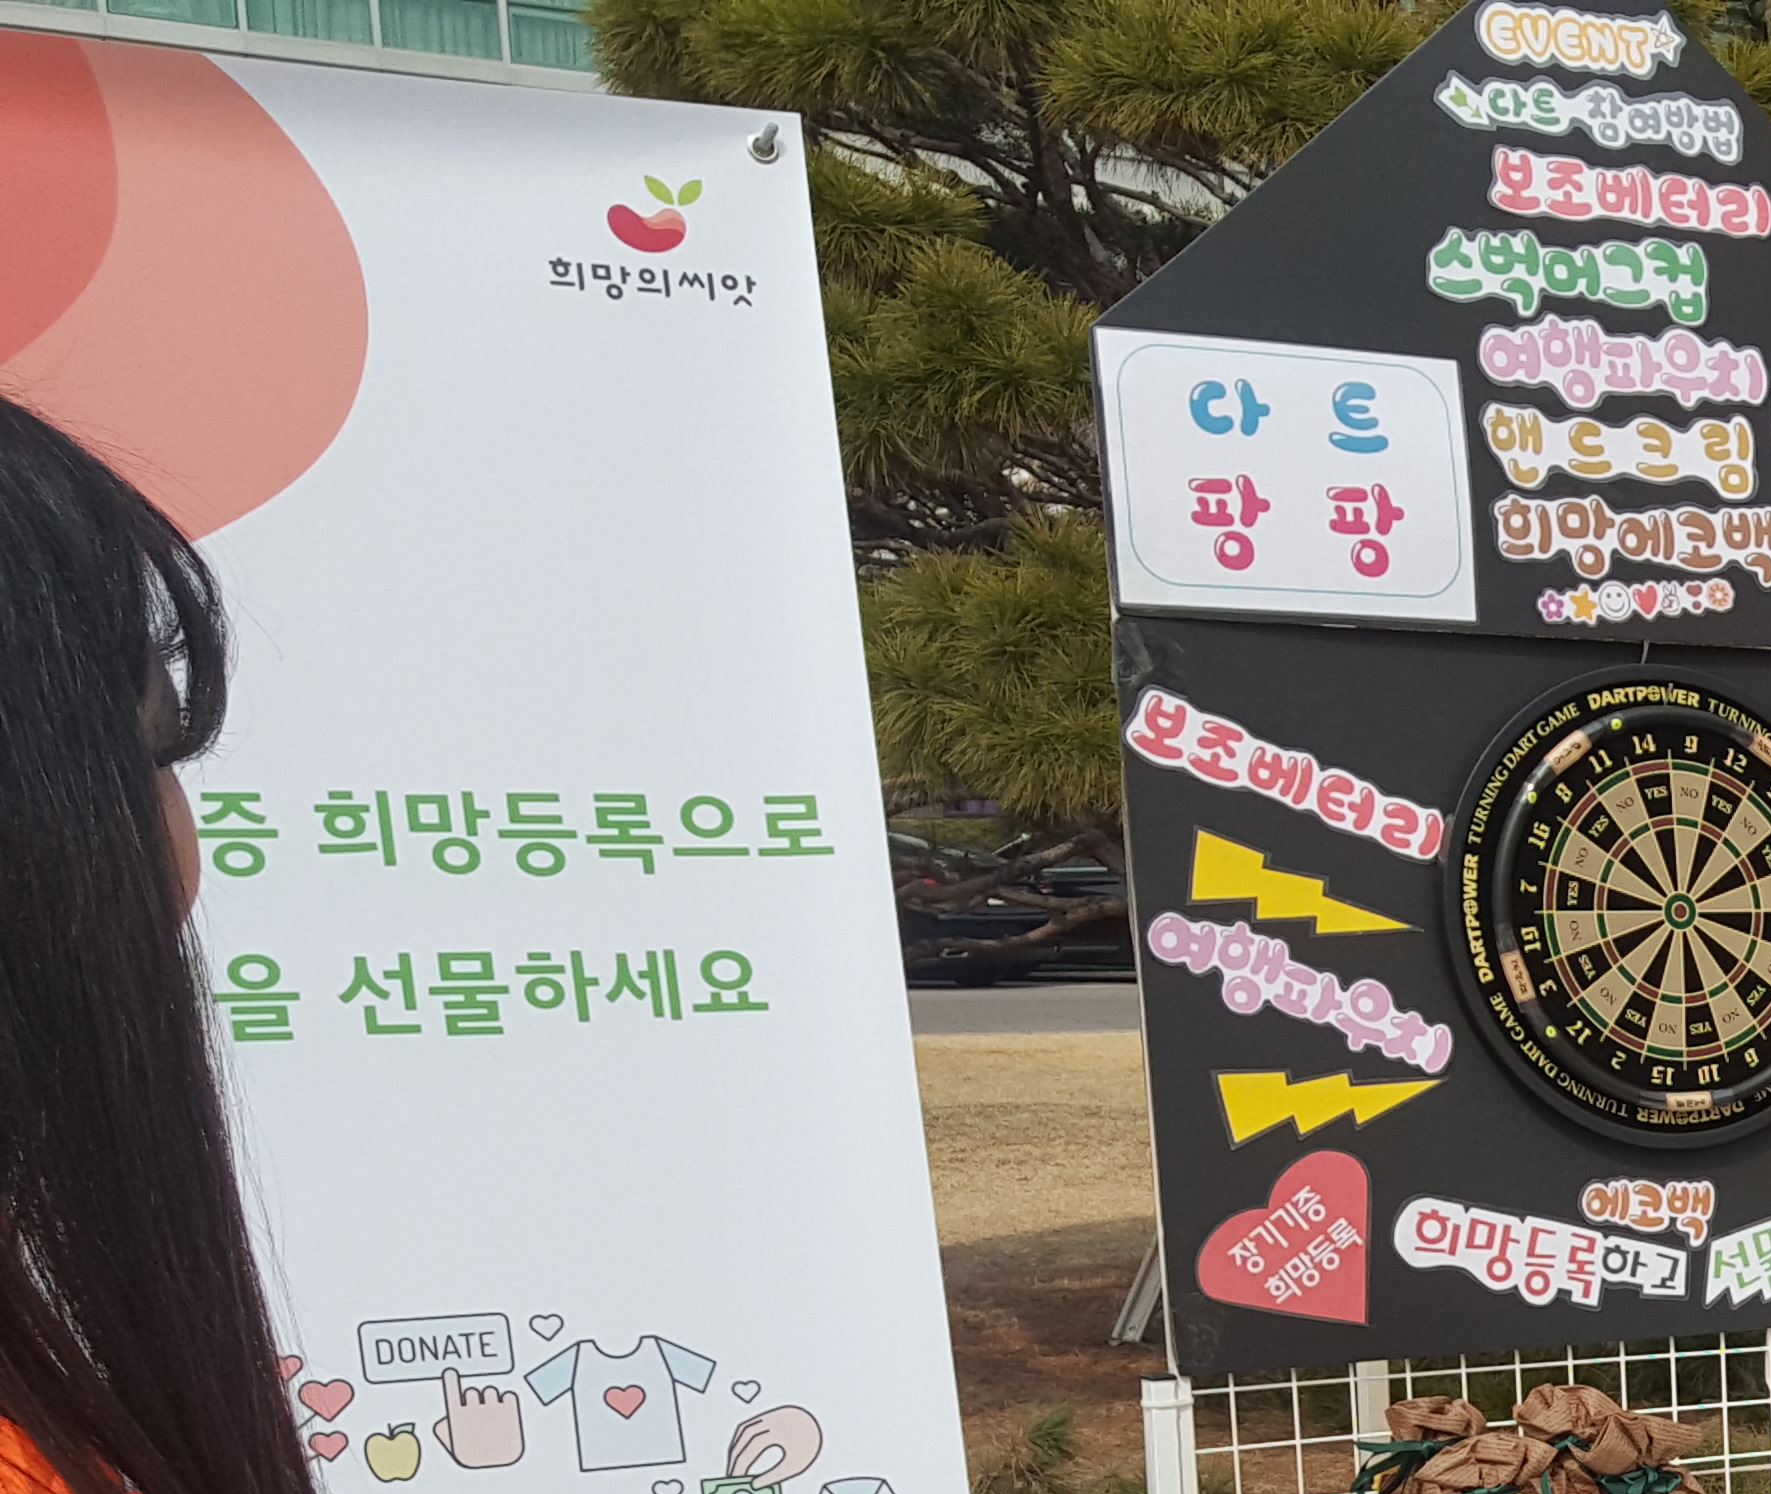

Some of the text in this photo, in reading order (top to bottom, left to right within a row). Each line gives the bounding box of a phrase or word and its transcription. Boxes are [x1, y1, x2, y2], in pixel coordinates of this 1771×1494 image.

[1486, 9, 1648, 69] EVENT
[1488, 88, 1734, 157] 다트 참여방법
[1495, 149, 1770, 234] 보조베터리
[547, 255, 758, 307] 희망의씨앗
[1483, 318, 1764, 404] 여행파우치
[1487, 408, 1750, 494] 핸드크림
[1587, 685, 1700, 711] DARTPOWER
[1632, 734, 1657, 754] 14
[1684, 736, 1699, 754] 9
[1588, 751, 1613, 774] 11
[1722, 747, 1748, 773] 12
[1139, 690, 1443, 860] 보조베터리
[1469, 765, 1509, 844] TURNING
[1503, 729, 1538, 769] DART
[1536, 702, 1581, 736] GAME
[1555, 783, 1572, 803] 8
[1616, 796, 1635, 812] NO
[1645, 785, 1668, 800] YES
[1680, 787, 1698, 798] NO
[1711, 794, 1733, 816] YES
[197, 788, 836, 878] 증 희망등록으로
[1528, 822, 1551, 849] 16
[1588, 815, 1609, 838] YES
[1740, 816, 1757, 836] NO
[1573, 847, 1589, 870] NO
[1520, 879, 1538, 894] 7
[1567, 880, 1579, 906] YES
[1462, 853, 1495, 984] DARTPOWER
[1569, 920, 1581, 942] NO
[1520, 927, 1541, 952] 19
[1578, 954, 1596, 980] YES
[212, 947, 769, 1042] 을 선물하세요
[1147, 915, 1451, 1074] 여행파우치
[1540, 980, 1558, 997] 3
[1600, 986, 1617, 1007] NO
[1747, 983, 1767, 1007] YES
[1625, 1007, 1648, 1027] YES
[1689, 1020, 1712, 1035] YES
[1721, 1007, 1741, 1024] NO
[1564, 1020, 1593, 1045] 17
[1658, 1022, 1678, 1035] NO
[1490, 992, 1629, 1119] TURNING DART GAME
[1610, 1050, 1628, 1070] 2
[1744, 1048, 1761, 1068] 6
[1651, 1066, 1675, 1085] 15
[1697, 1064, 1721, 1085] 10
[1582, 1181, 1714, 1241] 에코백
[1227, 1185, 1326, 1273] 장기기증
[1263, 1217, 1363, 1304] 희망등록
[1414, 1208, 1680, 1298] 희망등록하고
[374, 1331, 500, 1366] DONATE
